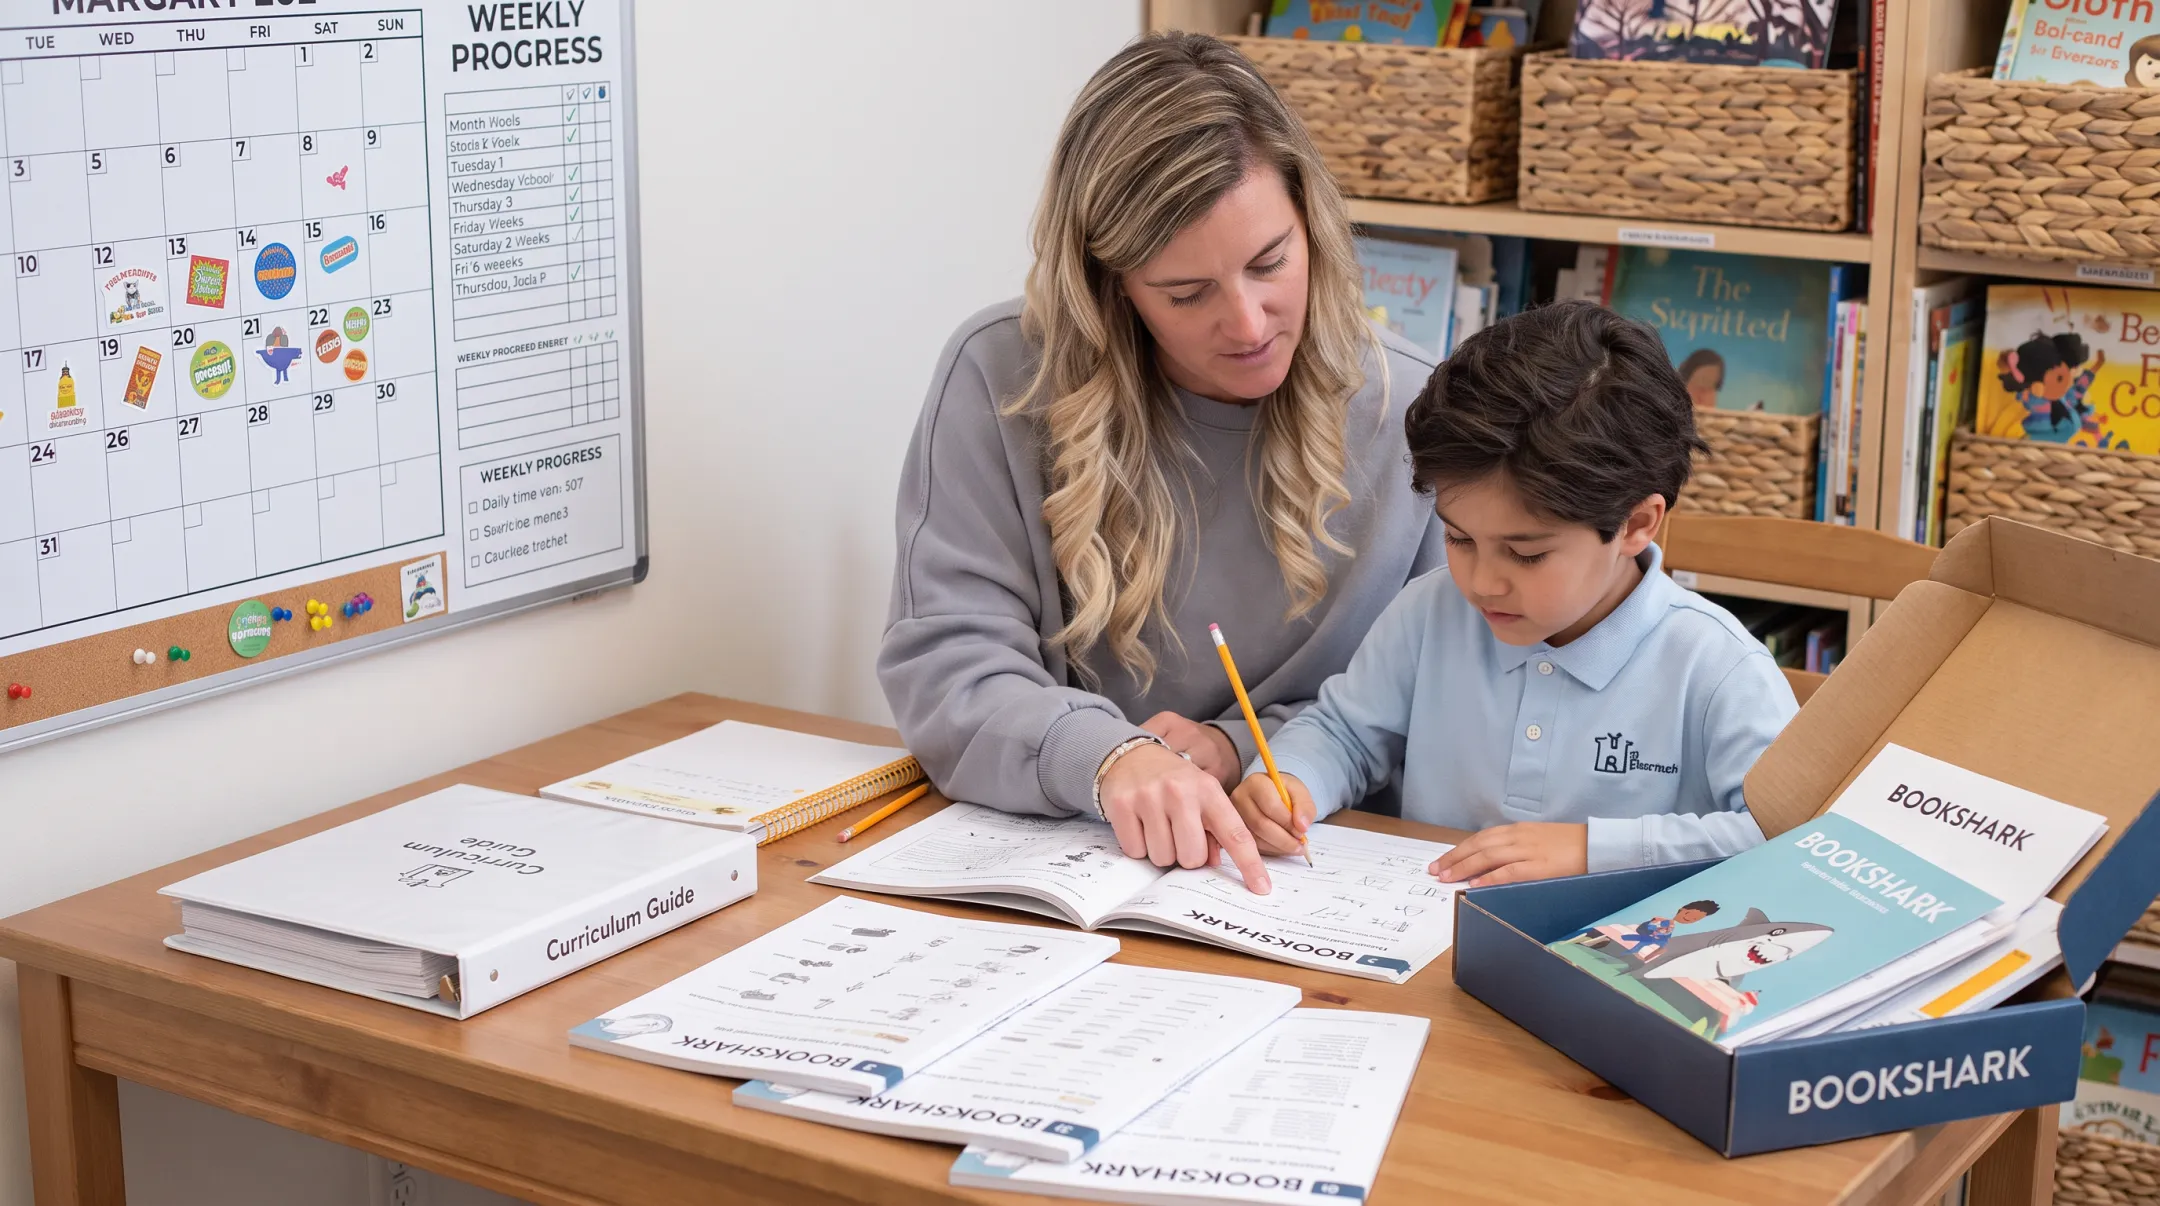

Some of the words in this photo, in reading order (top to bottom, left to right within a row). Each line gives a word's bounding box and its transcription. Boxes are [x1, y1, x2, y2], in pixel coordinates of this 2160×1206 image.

[378, 18, 404, 31] SUN
[467, 0, 585, 32] WEEKLY
[176, 29, 205, 42] THU
[250, 26, 271, 38] FRI
[314, 22, 338, 34] SAT
[26, 36, 54, 50] TUE
[99, 31, 134, 46] WED
[300, 47, 307, 62] 1
[364, 44, 373, 59] 2
[452, 36, 602, 72] PROGRESS
[450, 120, 486, 132] Month
[303, 136, 312, 152] 8
[368, 130, 377, 145] 9
[165, 148, 176, 164] 6
[236, 141, 246, 157] 7
[14, 160, 24, 178] 3
[92, 154, 102, 170] 5
[452, 158, 496, 174] Tuesday
[452, 178, 514, 194] Wednesday
[453, 198, 503, 214] Thursday
[506, 197, 513, 208] 3
[306, 222, 322, 238] 15
[370, 214, 385, 230] 16
[454, 221, 488, 235] Friday
[489, 216, 524, 230] Weeks
[169, 238, 186, 256] 13
[239, 230, 256, 247] 14
[454, 238, 502, 255] Saturday
[506, 237, 512, 249] 2
[516, 232, 550, 245] Weeks
[17, 255, 36, 274] 10
[95, 246, 113, 266] 12
[1694, 264, 1750, 302] The
[374, 300, 392, 316] 23
[310, 309, 328, 326] 22
[244, 318, 260, 336] 21
[173, 328, 194, 346] 20
[100, 338, 118, 356] 19
[24, 349, 42, 368] 17
[458, 351, 490, 363] WEEKLY
[376, 382, 395, 400] 30
[314, 394, 333, 411] 29
[248, 405, 268, 422] 28
[178, 418, 200, 436] 27
[106, 430, 129, 448] 26
[31, 442, 56, 462] 24
[480, 461, 533, 484] WEEKLY
[536, 446, 602, 472] PROGRESS
[483, 494, 509, 511] Daily
[513, 488, 536, 505] time
[40, 537, 58, 556] 31
[1887, 784, 2035, 852] BOOKSHARK
[460, 837, 536, 858] Guide
[402, 842, 544, 875] Curriculum
[1794, 831, 1956, 924] BOOKSHARK
[546, 911, 641, 961] Curriculum
[646, 886, 695, 920] Guide
[1182, 909, 1355, 961] BOOKSHARK
[672, 1036, 852, 1067] BOOKSHARK
[1788, 1044, 2032, 1114] BOOKSHARK
[1081, 1160, 1302, 1192] BOOKSHARK
